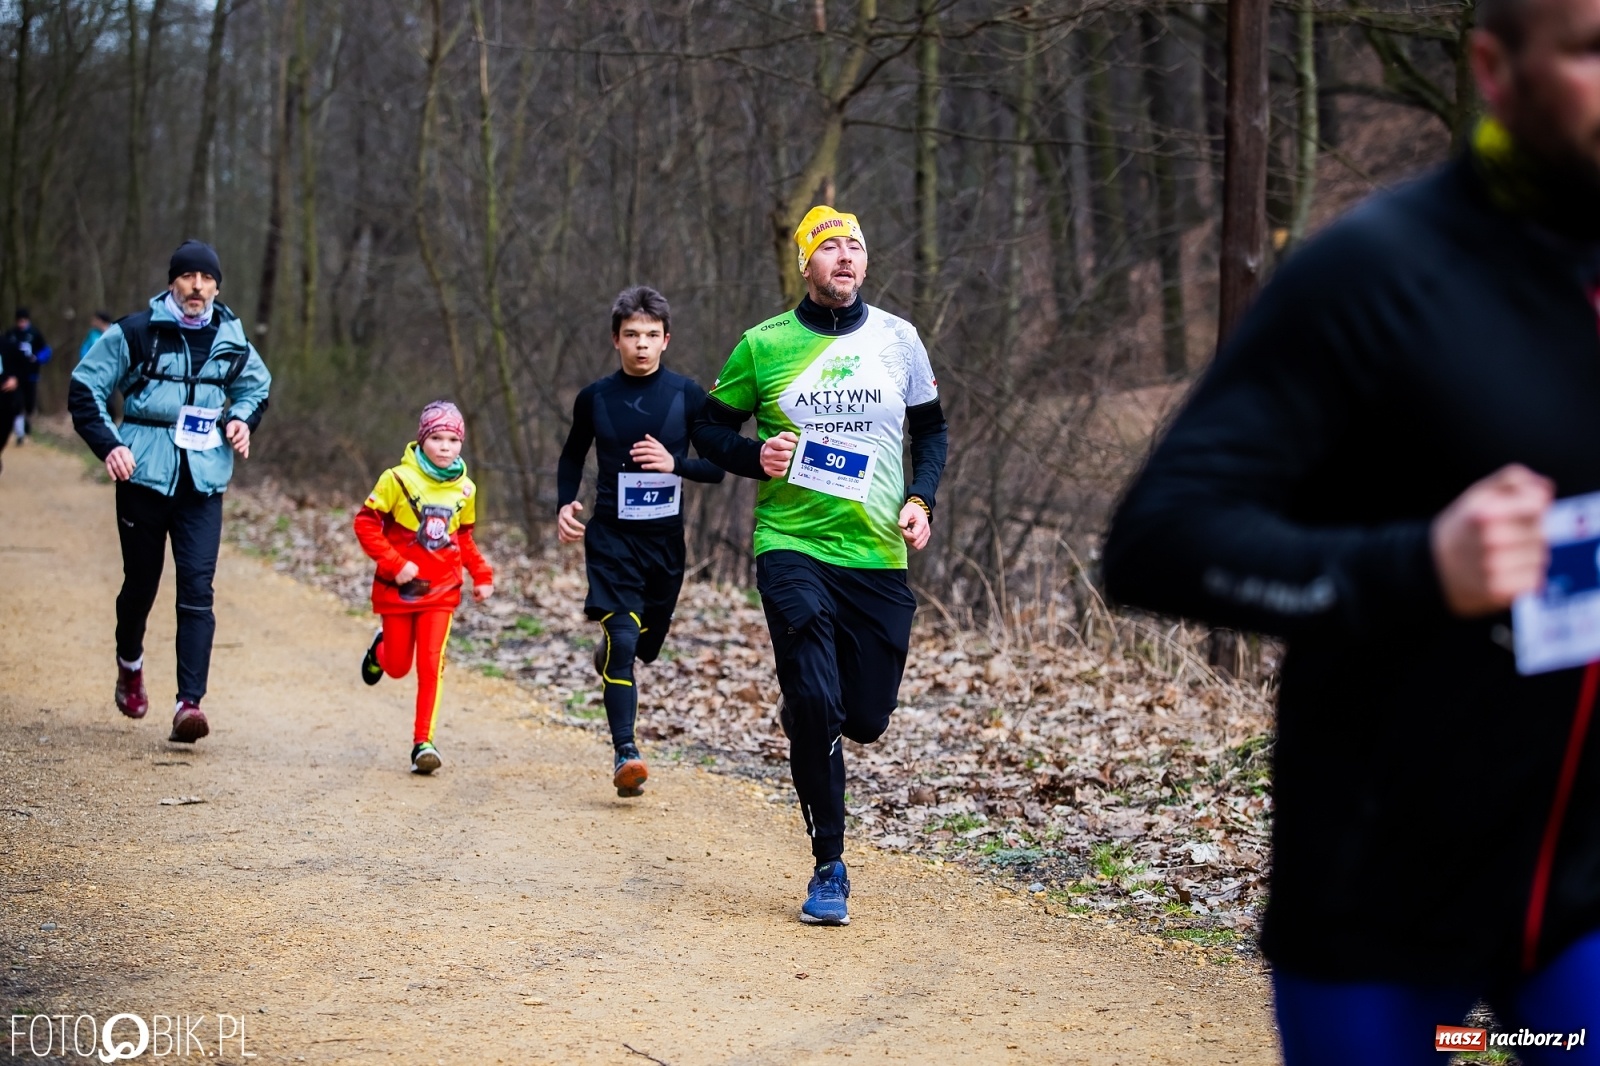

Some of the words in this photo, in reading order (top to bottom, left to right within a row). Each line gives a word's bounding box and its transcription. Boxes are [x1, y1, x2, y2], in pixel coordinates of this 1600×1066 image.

[811, 219, 843, 238] MARATON
[760, 319, 791, 331] deep
[795, 389, 881, 407] AKTYWNI
[815, 404, 865, 414] LYSKI
[825, 452, 846, 469] 90
[643, 491, 659, 503] 47
